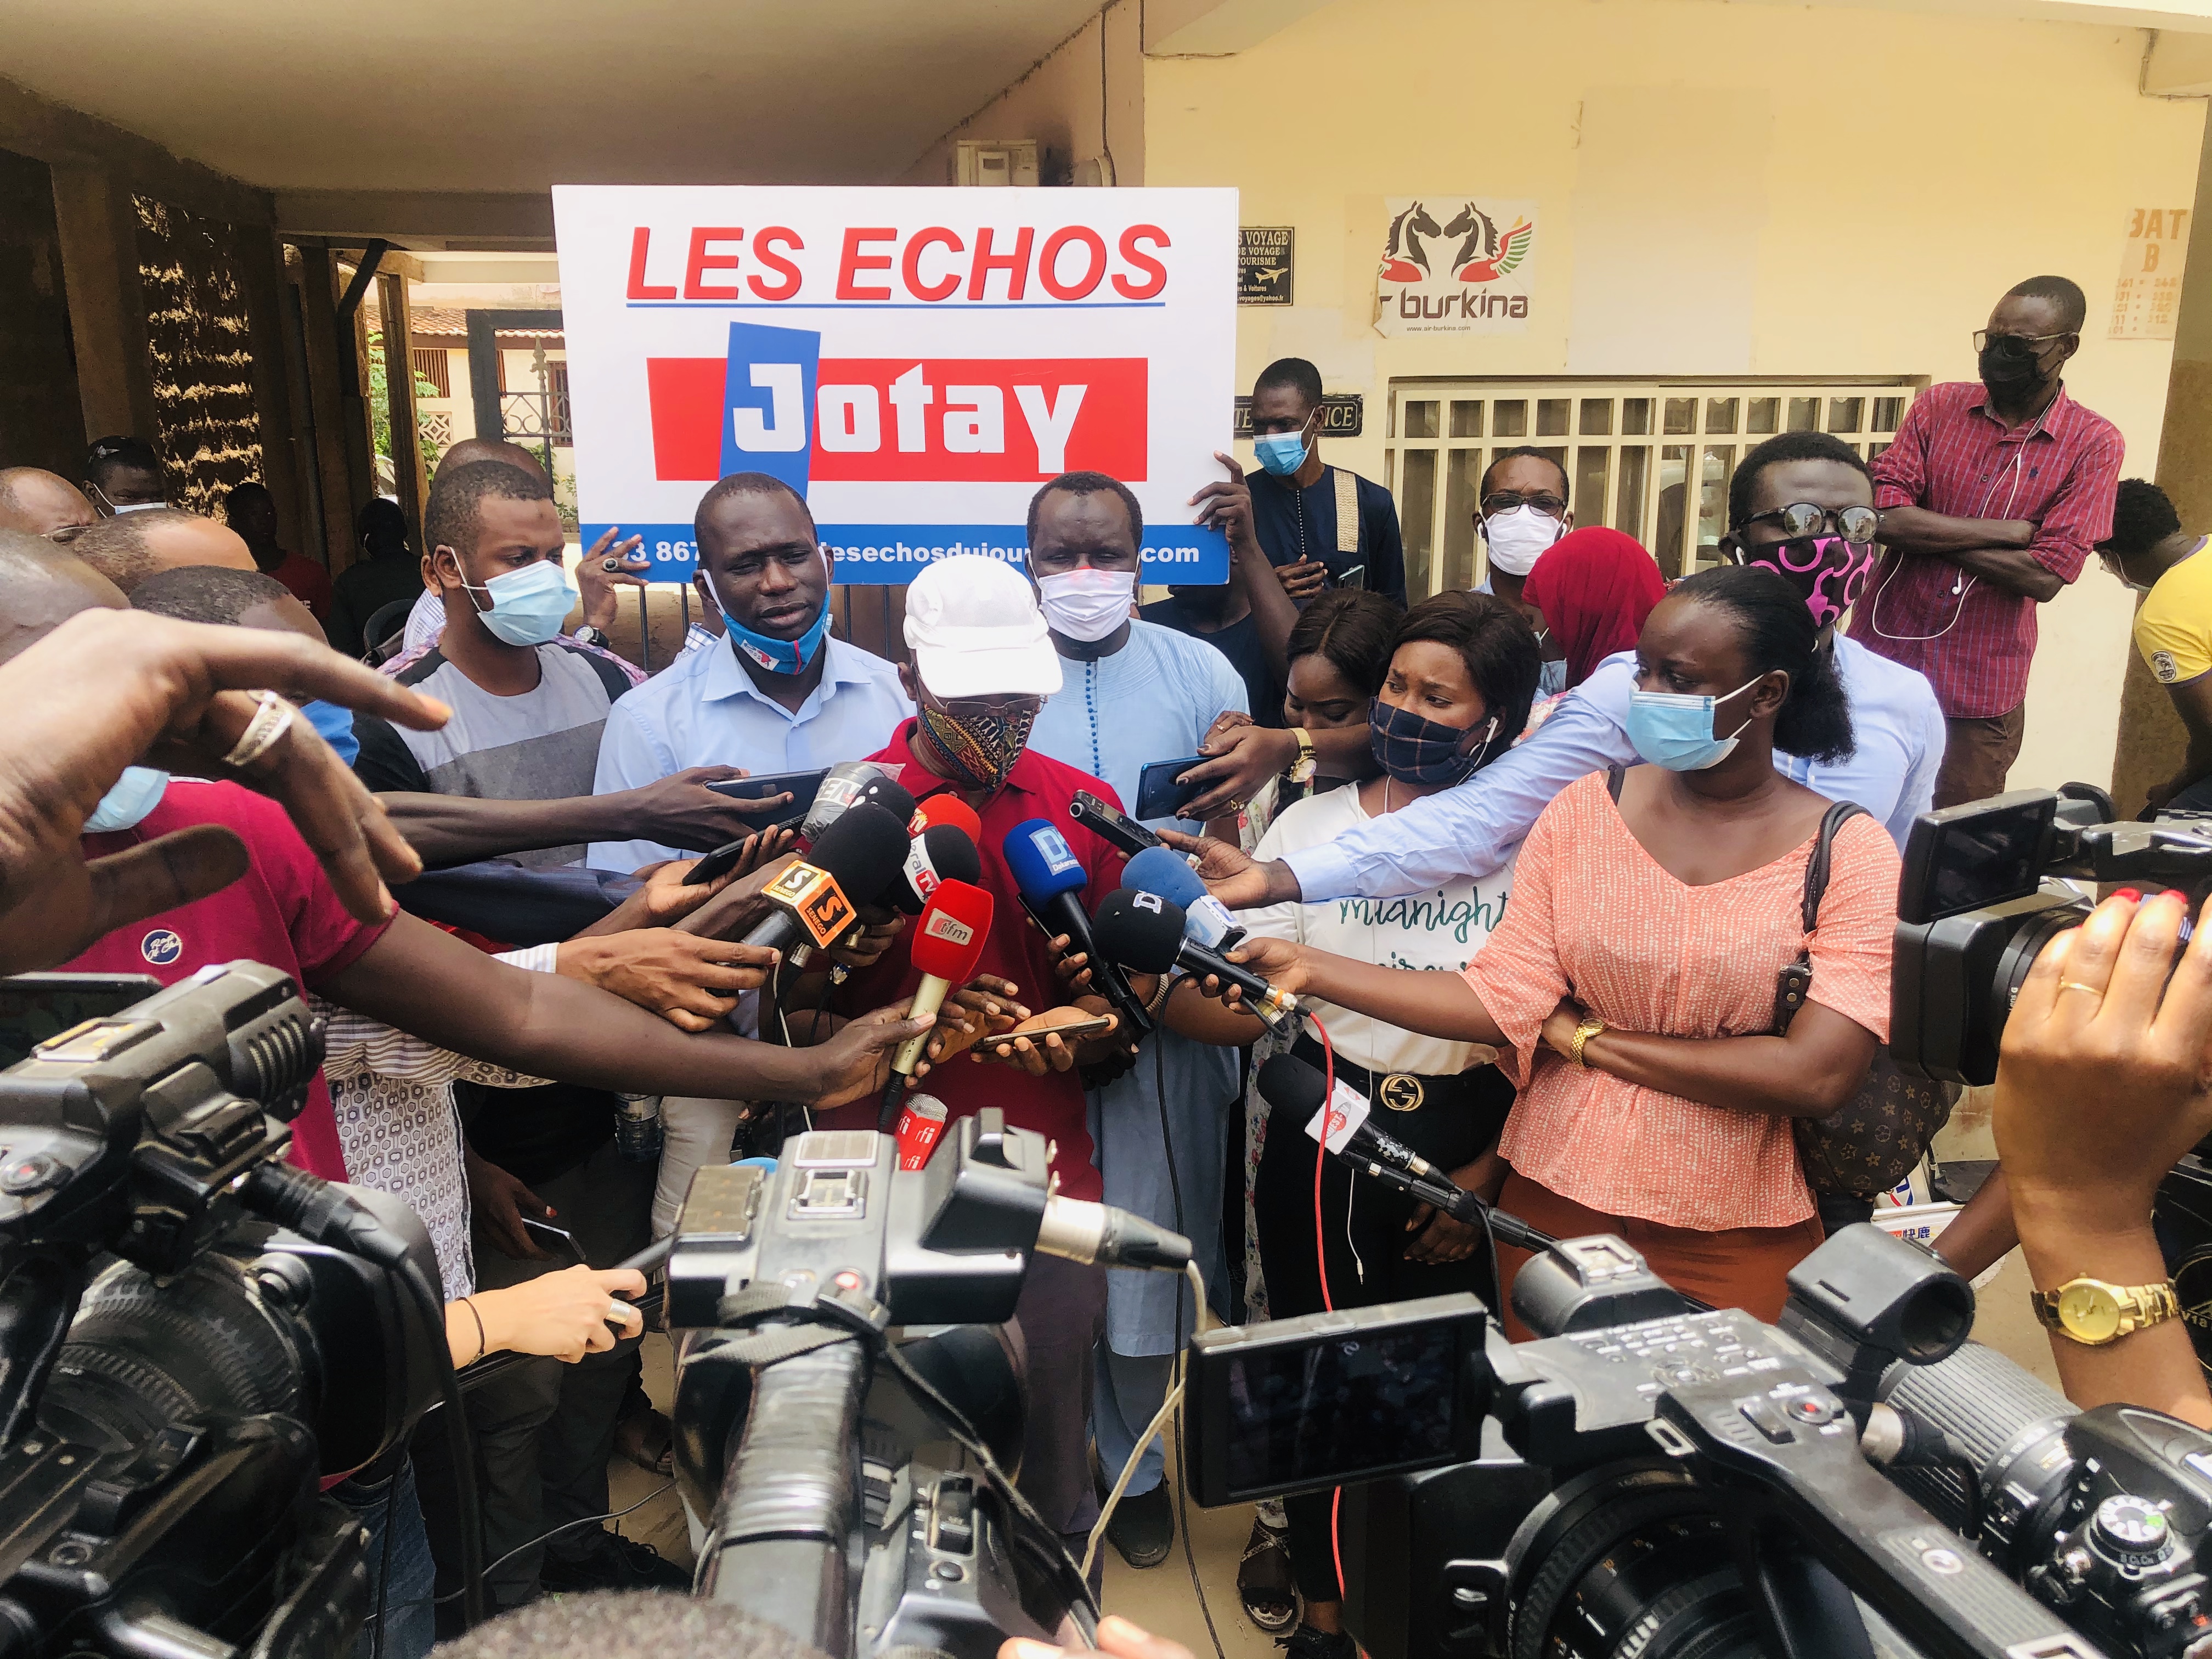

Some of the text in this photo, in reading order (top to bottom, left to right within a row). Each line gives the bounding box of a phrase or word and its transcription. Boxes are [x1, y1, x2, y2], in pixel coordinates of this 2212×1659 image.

[1246, 231, 1288, 245] VOYAGE
[1249, 247, 1280, 256] VOYAGE
[626, 224, 1171, 302] LES ECHOS
[1400, 287, 1528, 319] burkina
[612, 541, 646, 562] 3
[773, 884, 796, 897] SENEGO
[919, 872, 937, 893] TV
[806, 907, 827, 934] SENEGO
[915, 1126, 935, 1144] rfi
[904, 1155, 921, 1169] rfi
